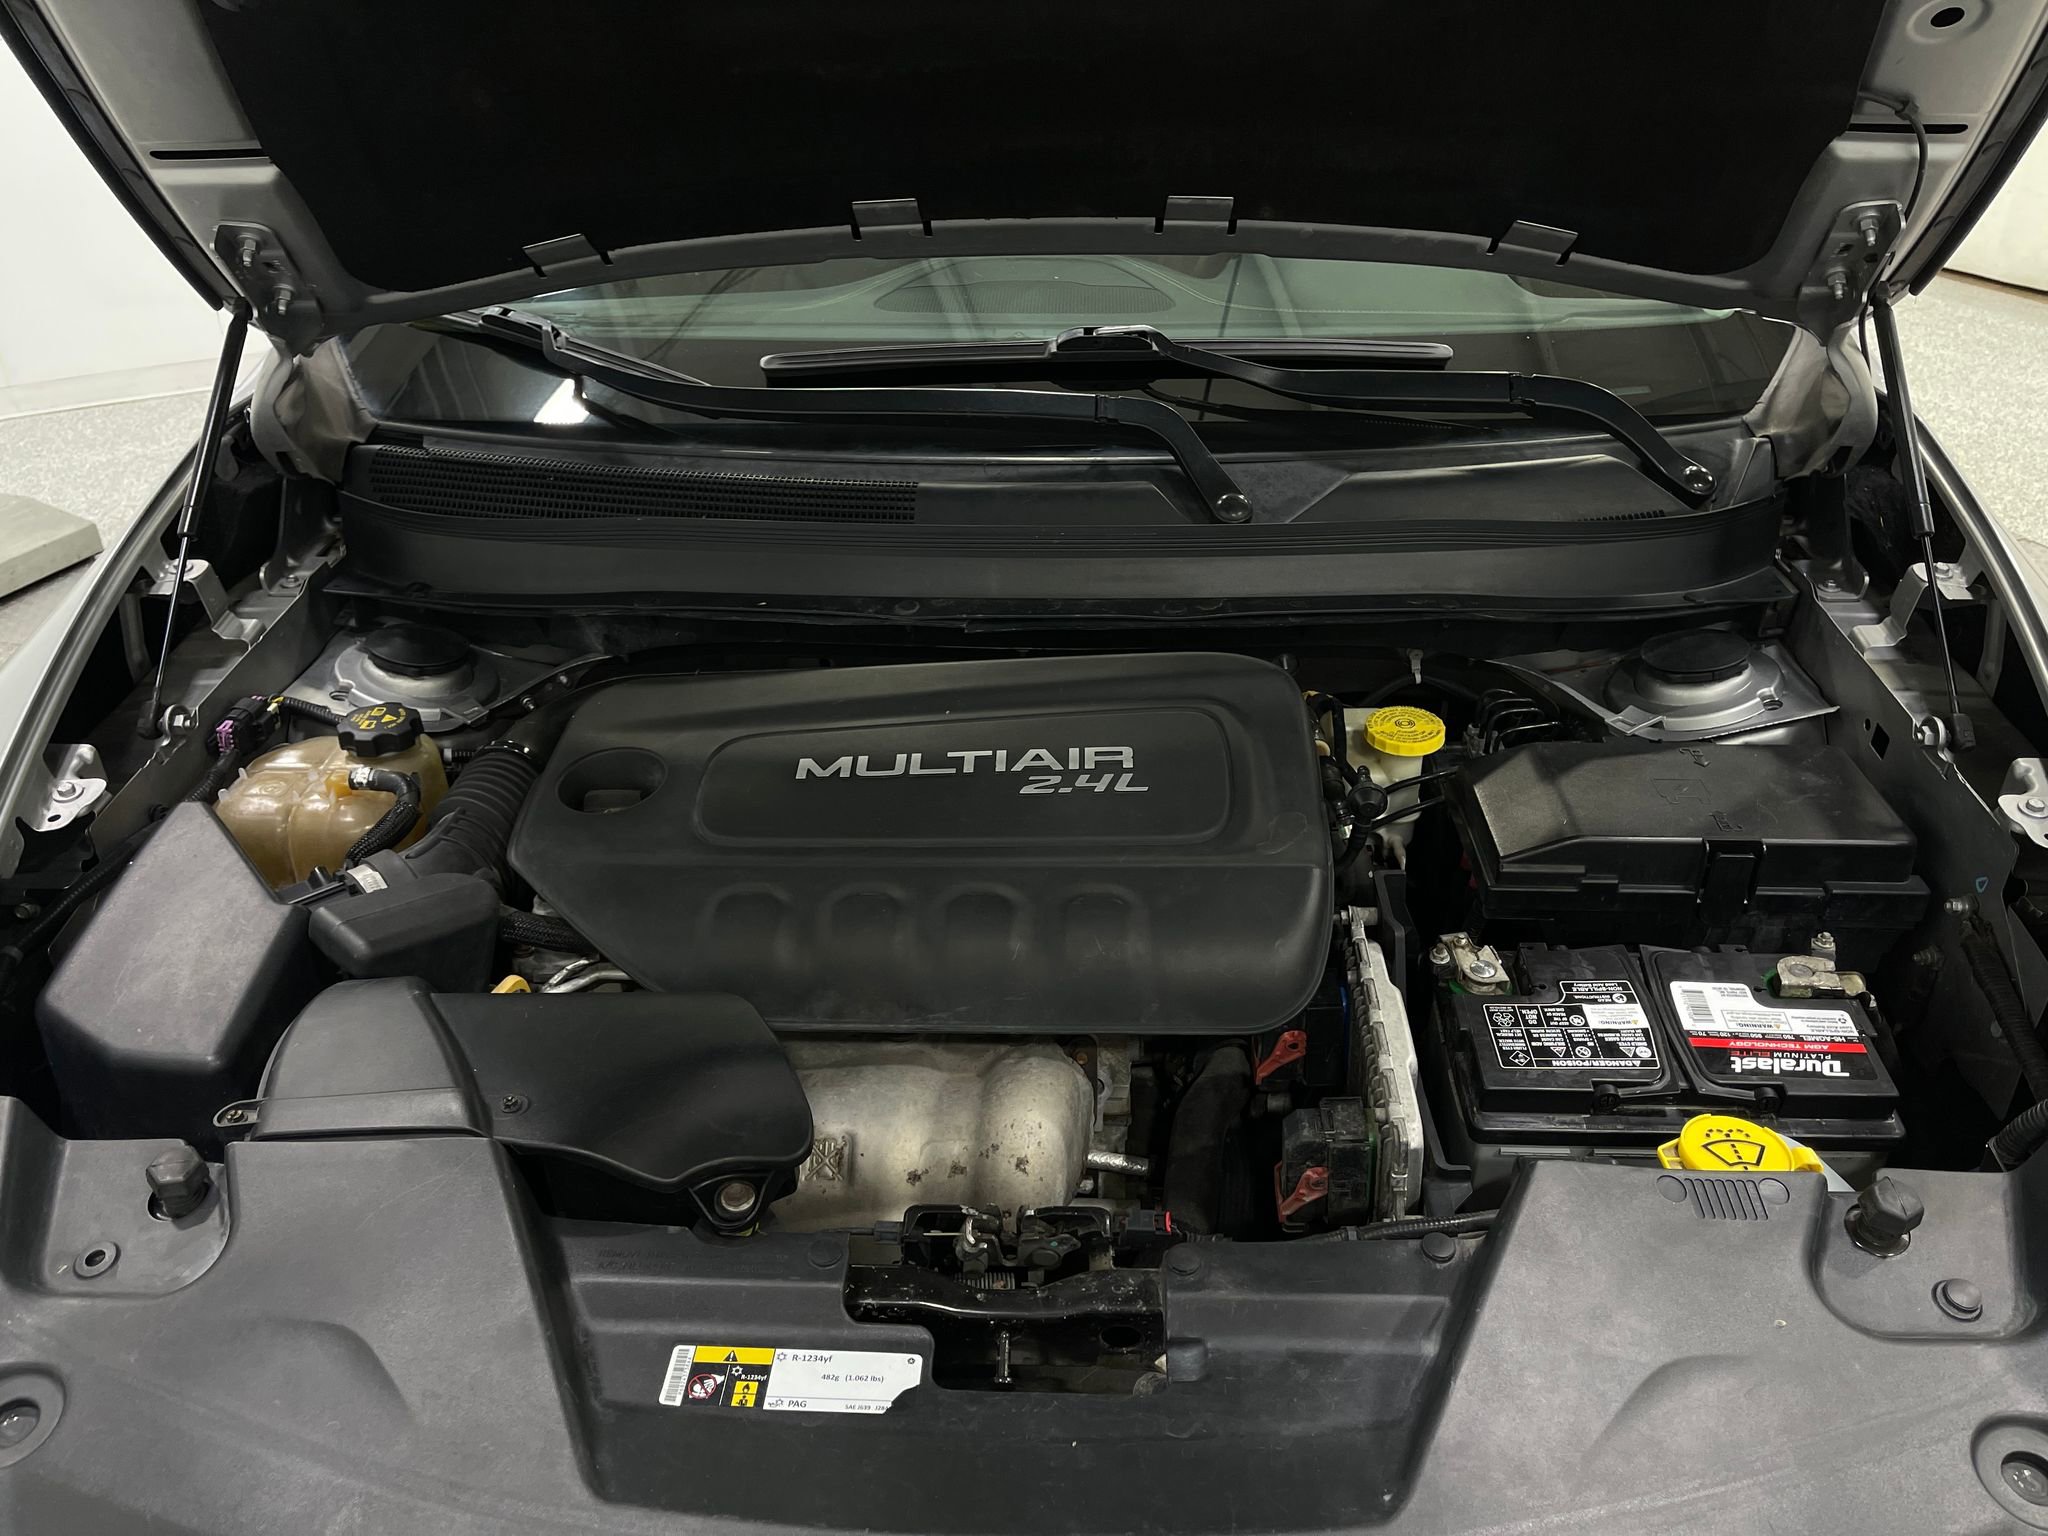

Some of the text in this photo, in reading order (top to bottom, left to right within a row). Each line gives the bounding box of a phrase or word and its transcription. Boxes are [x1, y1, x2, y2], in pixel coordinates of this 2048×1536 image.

[795, 746, 1135, 780] MULTIAIR
[1018, 773, 1150, 794] 2.4L
[1729, 1041, 1801, 1049] TECHNOLOGY
[1773, 1052, 1831, 1060] PLATINUM
[1730, 1056, 1850, 1077] Duralast
[792, 1354, 833, 1364] R-1234yf
[821, 1374, 885, 1383] 482g (1.062 lbs)
[788, 1400, 807, 1408] PAG
